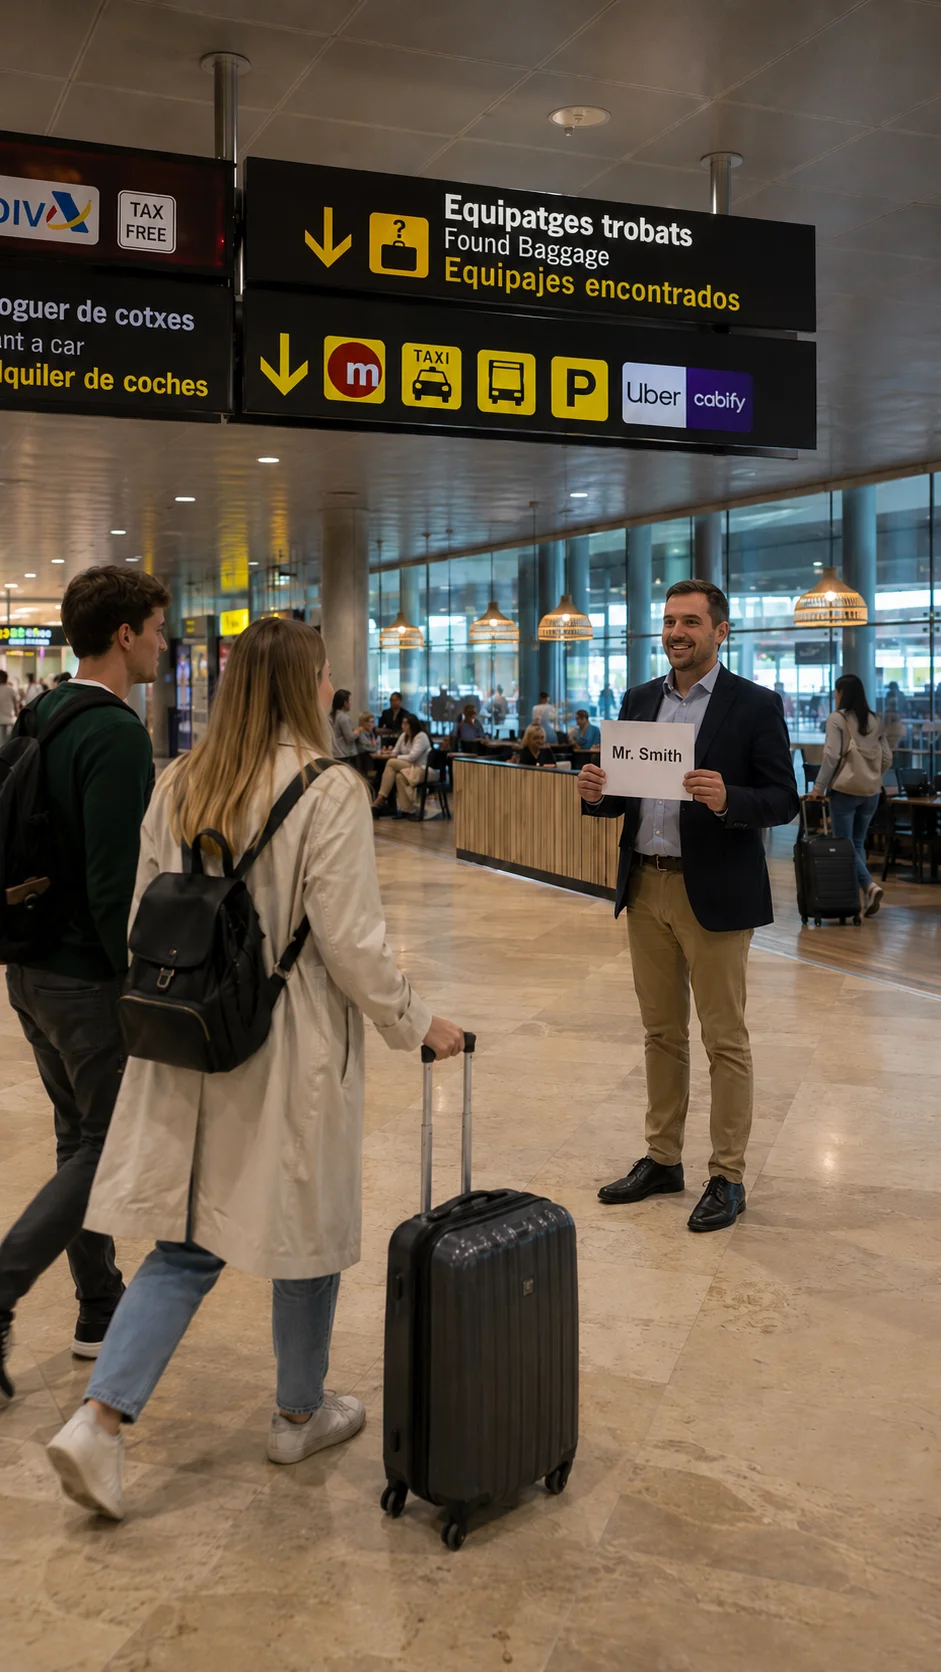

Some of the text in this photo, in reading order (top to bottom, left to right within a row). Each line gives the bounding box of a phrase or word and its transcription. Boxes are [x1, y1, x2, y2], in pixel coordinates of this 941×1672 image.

[130, 201, 164, 220] TAX
[445, 193, 693, 247] Equipatges trobats
[126, 223, 167, 243] FREE
[445, 227, 610, 270] Found Baggage
[445, 256, 741, 311] Equipajes encontrados
[76, 299, 107, 324] de
[115, 306, 196, 331] cotxes
[0, 332, 85, 356] nt a car
[413, 349, 449, 364] TAXI
[84, 367, 114, 391] de
[123, 372, 209, 397] coches
[346, 361, 379, 387] m
[566, 368, 597, 408] P
[627, 381, 682, 406] Uber
[693, 390, 746, 413] cabify
[612, 745, 682, 763] Mr. Smith
